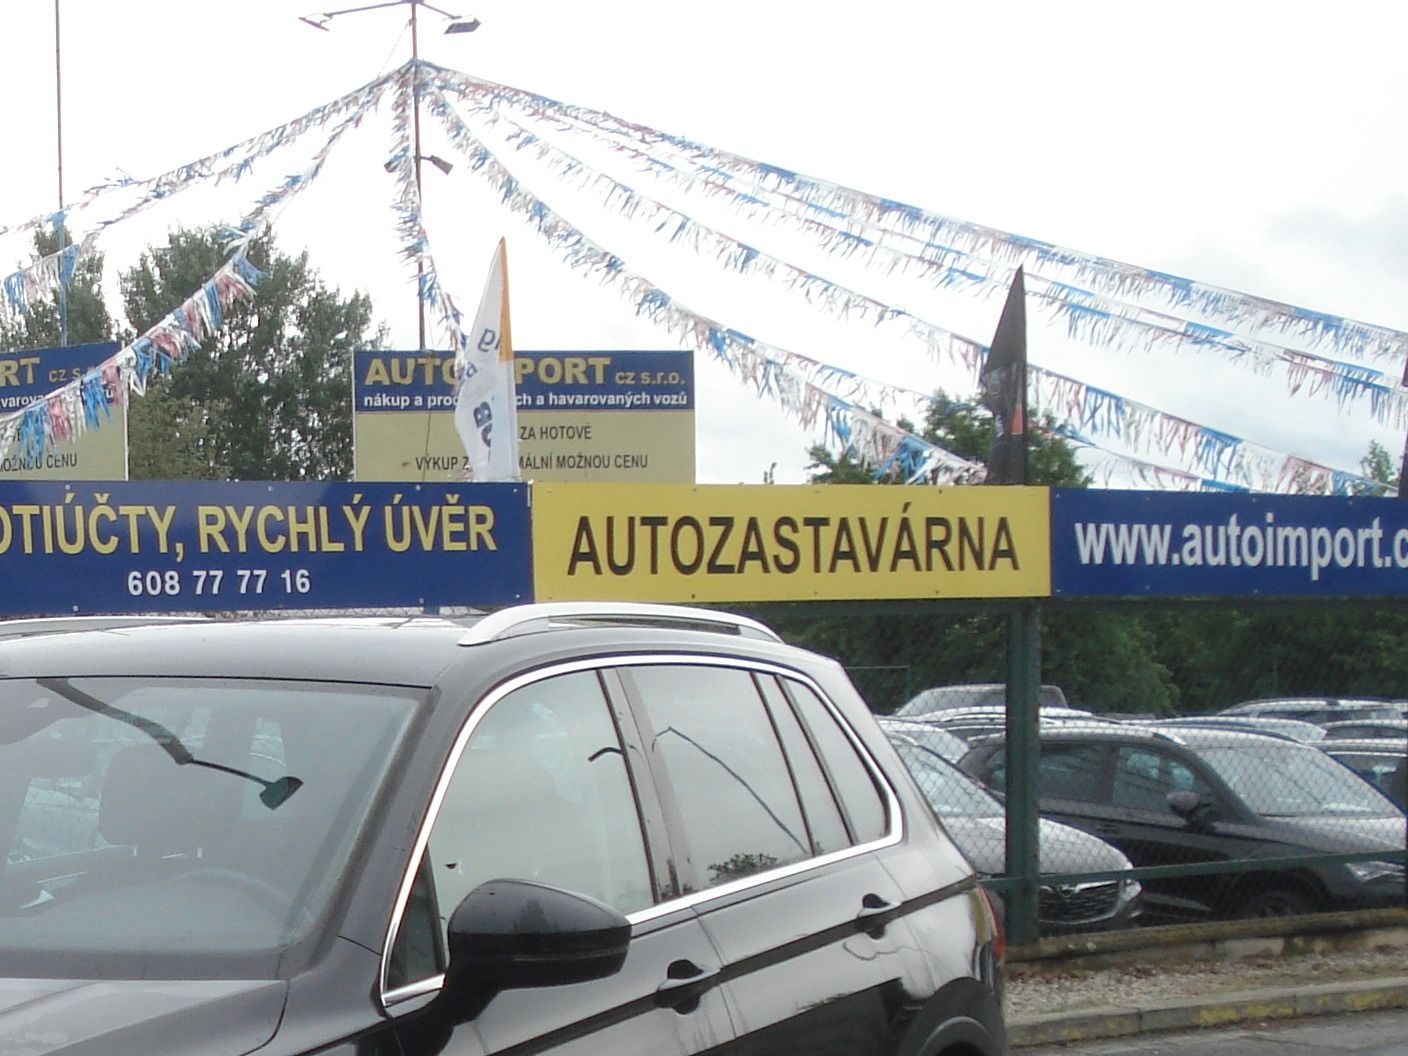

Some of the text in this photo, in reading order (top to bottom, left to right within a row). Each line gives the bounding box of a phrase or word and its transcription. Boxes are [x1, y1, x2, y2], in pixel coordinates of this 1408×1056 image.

[365, 357, 611, 386] AUTOPORT
[615, 372, 635, 385] cz
[640, 372, 685, 385] s.r.o.
[364, 393, 410, 409] nákup
[414, 395, 423, 406] a
[536, 394, 545, 406] a
[549, 391, 650, 408] havarovaných
[653, 391, 687, 405] vozů
[520, 421, 592, 440] ZA HOTOVÉ
[46, 453, 78, 469] CENU
[415, 453, 458, 470] VÝKUP
[556, 451, 610, 470] MOŽNOU
[614, 455, 648, 469] CENU
[199, 494, 371, 553] RYCHLÝ
[384, 493, 497, 552] ÚVĚR
[567, 502, 1020, 577] AUTOZASTAVÁRNA
[127, 569, 312, 596] 608 77 77 16
